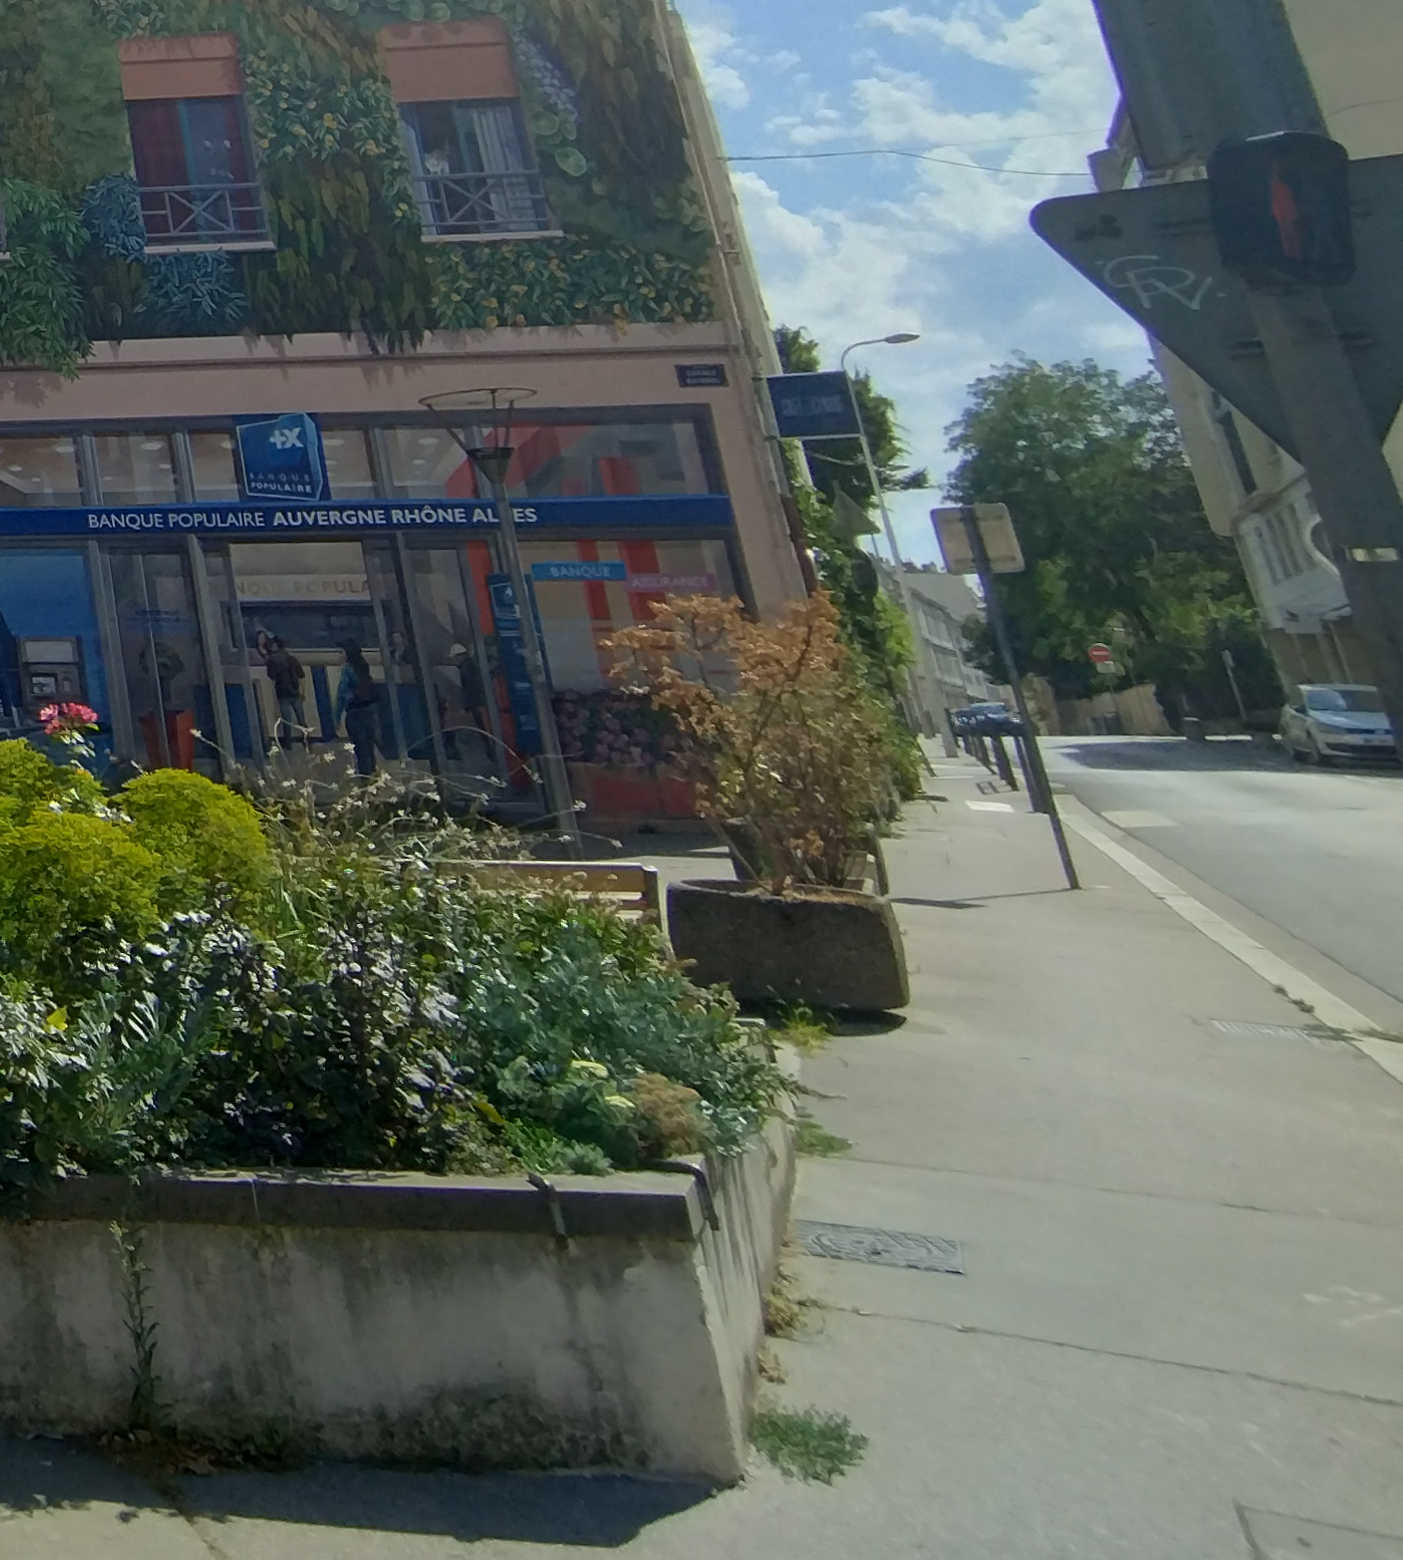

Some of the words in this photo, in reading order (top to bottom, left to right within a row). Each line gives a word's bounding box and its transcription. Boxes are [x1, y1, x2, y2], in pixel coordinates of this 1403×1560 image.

[249, 471, 311, 482] BANQUE
[250, 481, 313, 494] POPULAIRE
[88, 513, 165, 529] BANQUE
[168, 511, 265, 529] POPULAIRE
[272, 509, 389, 527] AUVERGNE
[391, 504, 467, 525] RHÔNE
[471, 506, 539, 524] ALES
[548, 564, 611, 579] BANQUE
[630, 574, 710, 589] ASSURANCE
